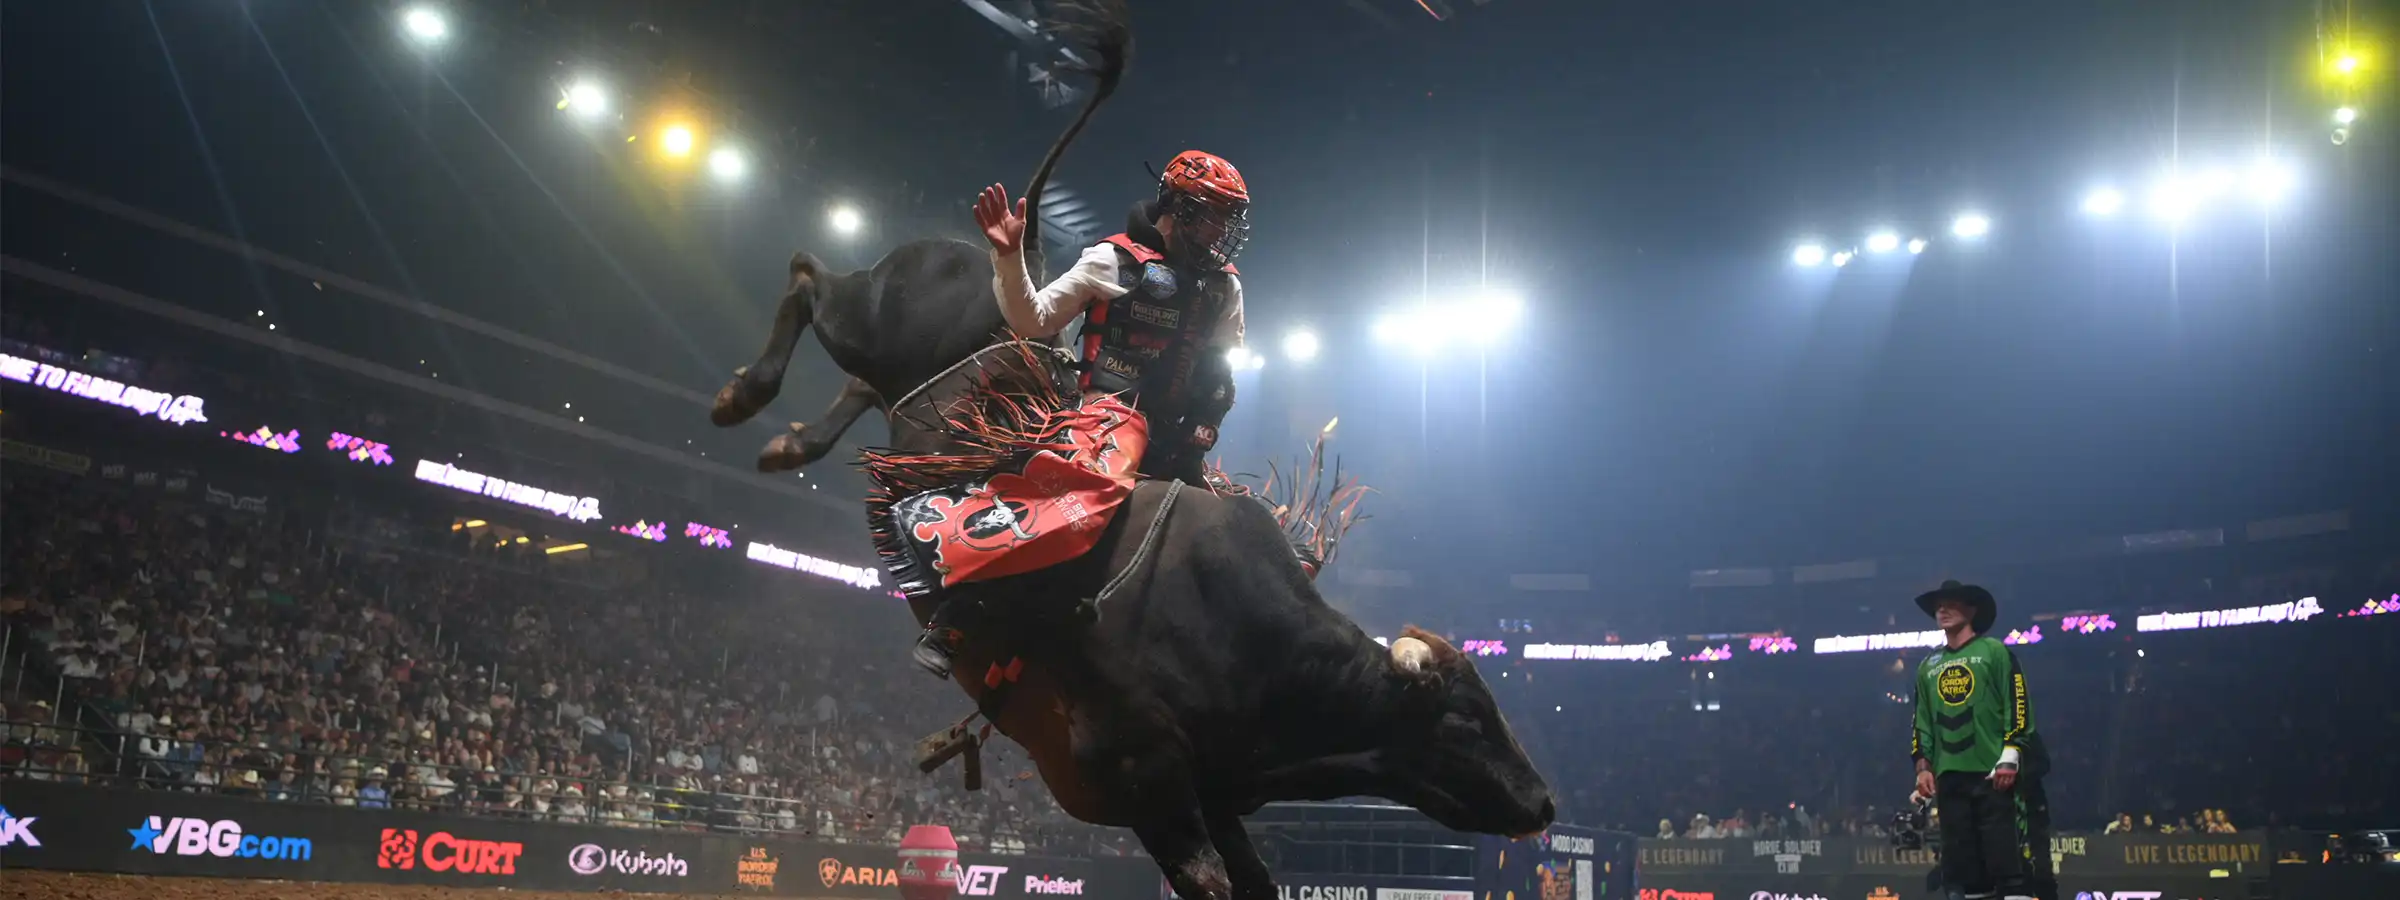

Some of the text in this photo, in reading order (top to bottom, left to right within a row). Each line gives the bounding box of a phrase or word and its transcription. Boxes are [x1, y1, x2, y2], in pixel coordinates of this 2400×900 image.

[35, 363, 67, 390] TO
[1105, 356, 1139, 378] PALMS
[2201, 611, 2220, 628] TO
[1970, 656, 1982, 664] BY
[2014, 674, 2024, 697] TEAM
[148, 815, 312, 861] VBG.com
[1571, 836, 1594, 856] CASINO
[2050, 836, 2086, 856] OLDIER
[422, 831, 522, 875] CURT
[610, 848, 688, 877] Kubota
[1856, 846, 1886, 865] LIVE
[2124, 843, 2260, 865] LIVE LEGENDARY
[841, 866, 899, 887] ARIA
[956, 864, 1009, 896] VET
[1025, 873, 1082, 895] Priefert
[1301, 885, 1368, 900] CASINO
